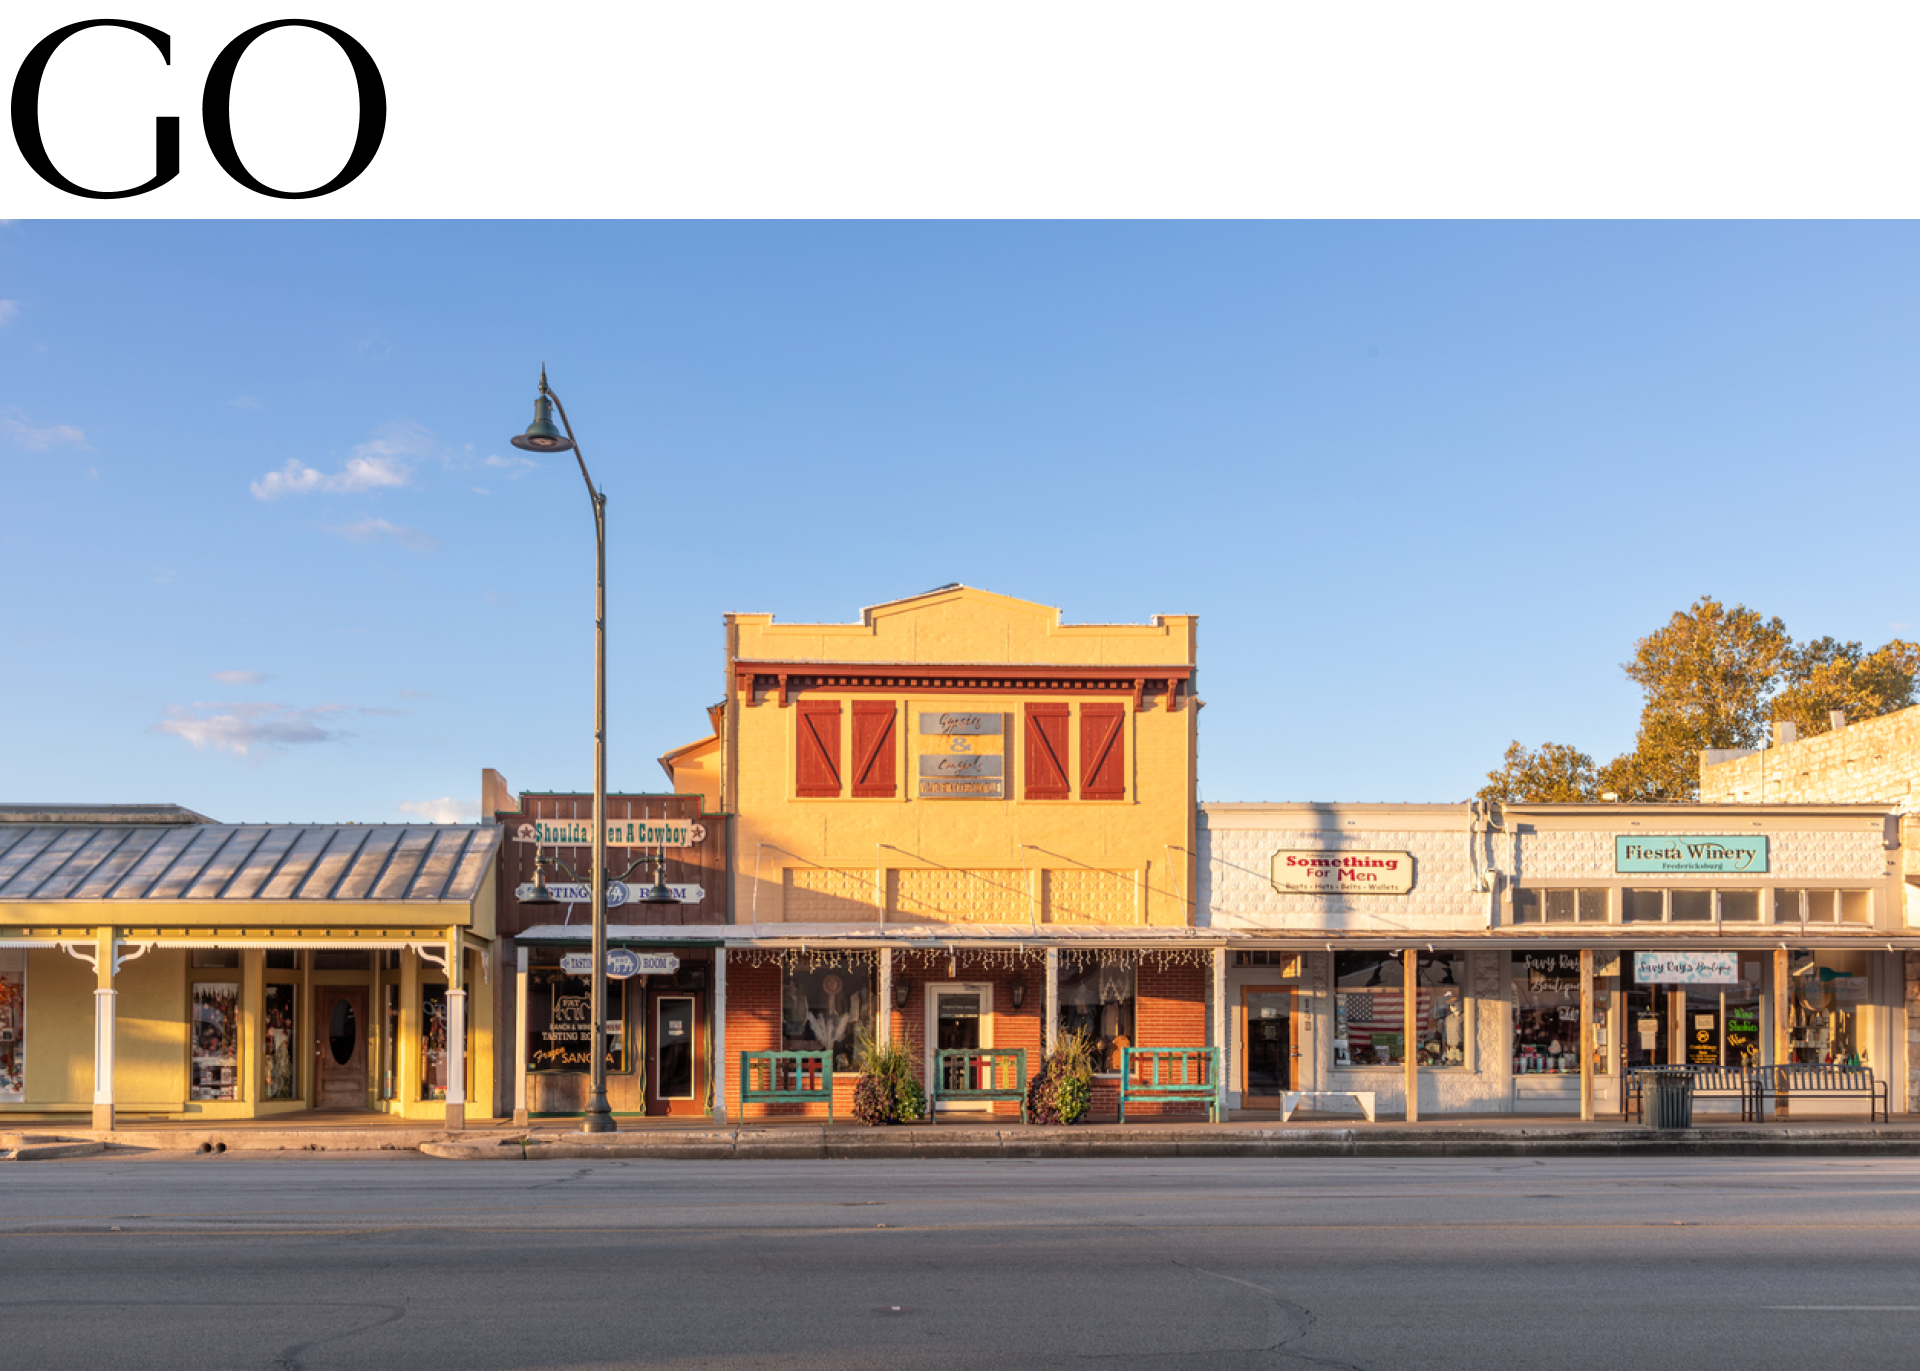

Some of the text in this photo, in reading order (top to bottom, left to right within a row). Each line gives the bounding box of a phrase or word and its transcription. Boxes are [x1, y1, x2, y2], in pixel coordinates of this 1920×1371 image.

[949, 737, 971, 752] &
[536, 823, 587, 843] Shoulda
[627, 823, 635, 842] A
[639, 823, 687, 846] Cowboy
[1625, 837, 1757, 870] Fiesta Winery
[1286, 855, 1398, 870] Something
[1662, 862, 1723, 870] Fredericksburg
[1306, 868, 1377, 881] For Men
[640, 887, 687, 899] RM
[643, 958, 667, 968] ROOM
[542, 1031, 578, 1040] TASTING
[561, 1052, 615, 1063] SANGA
